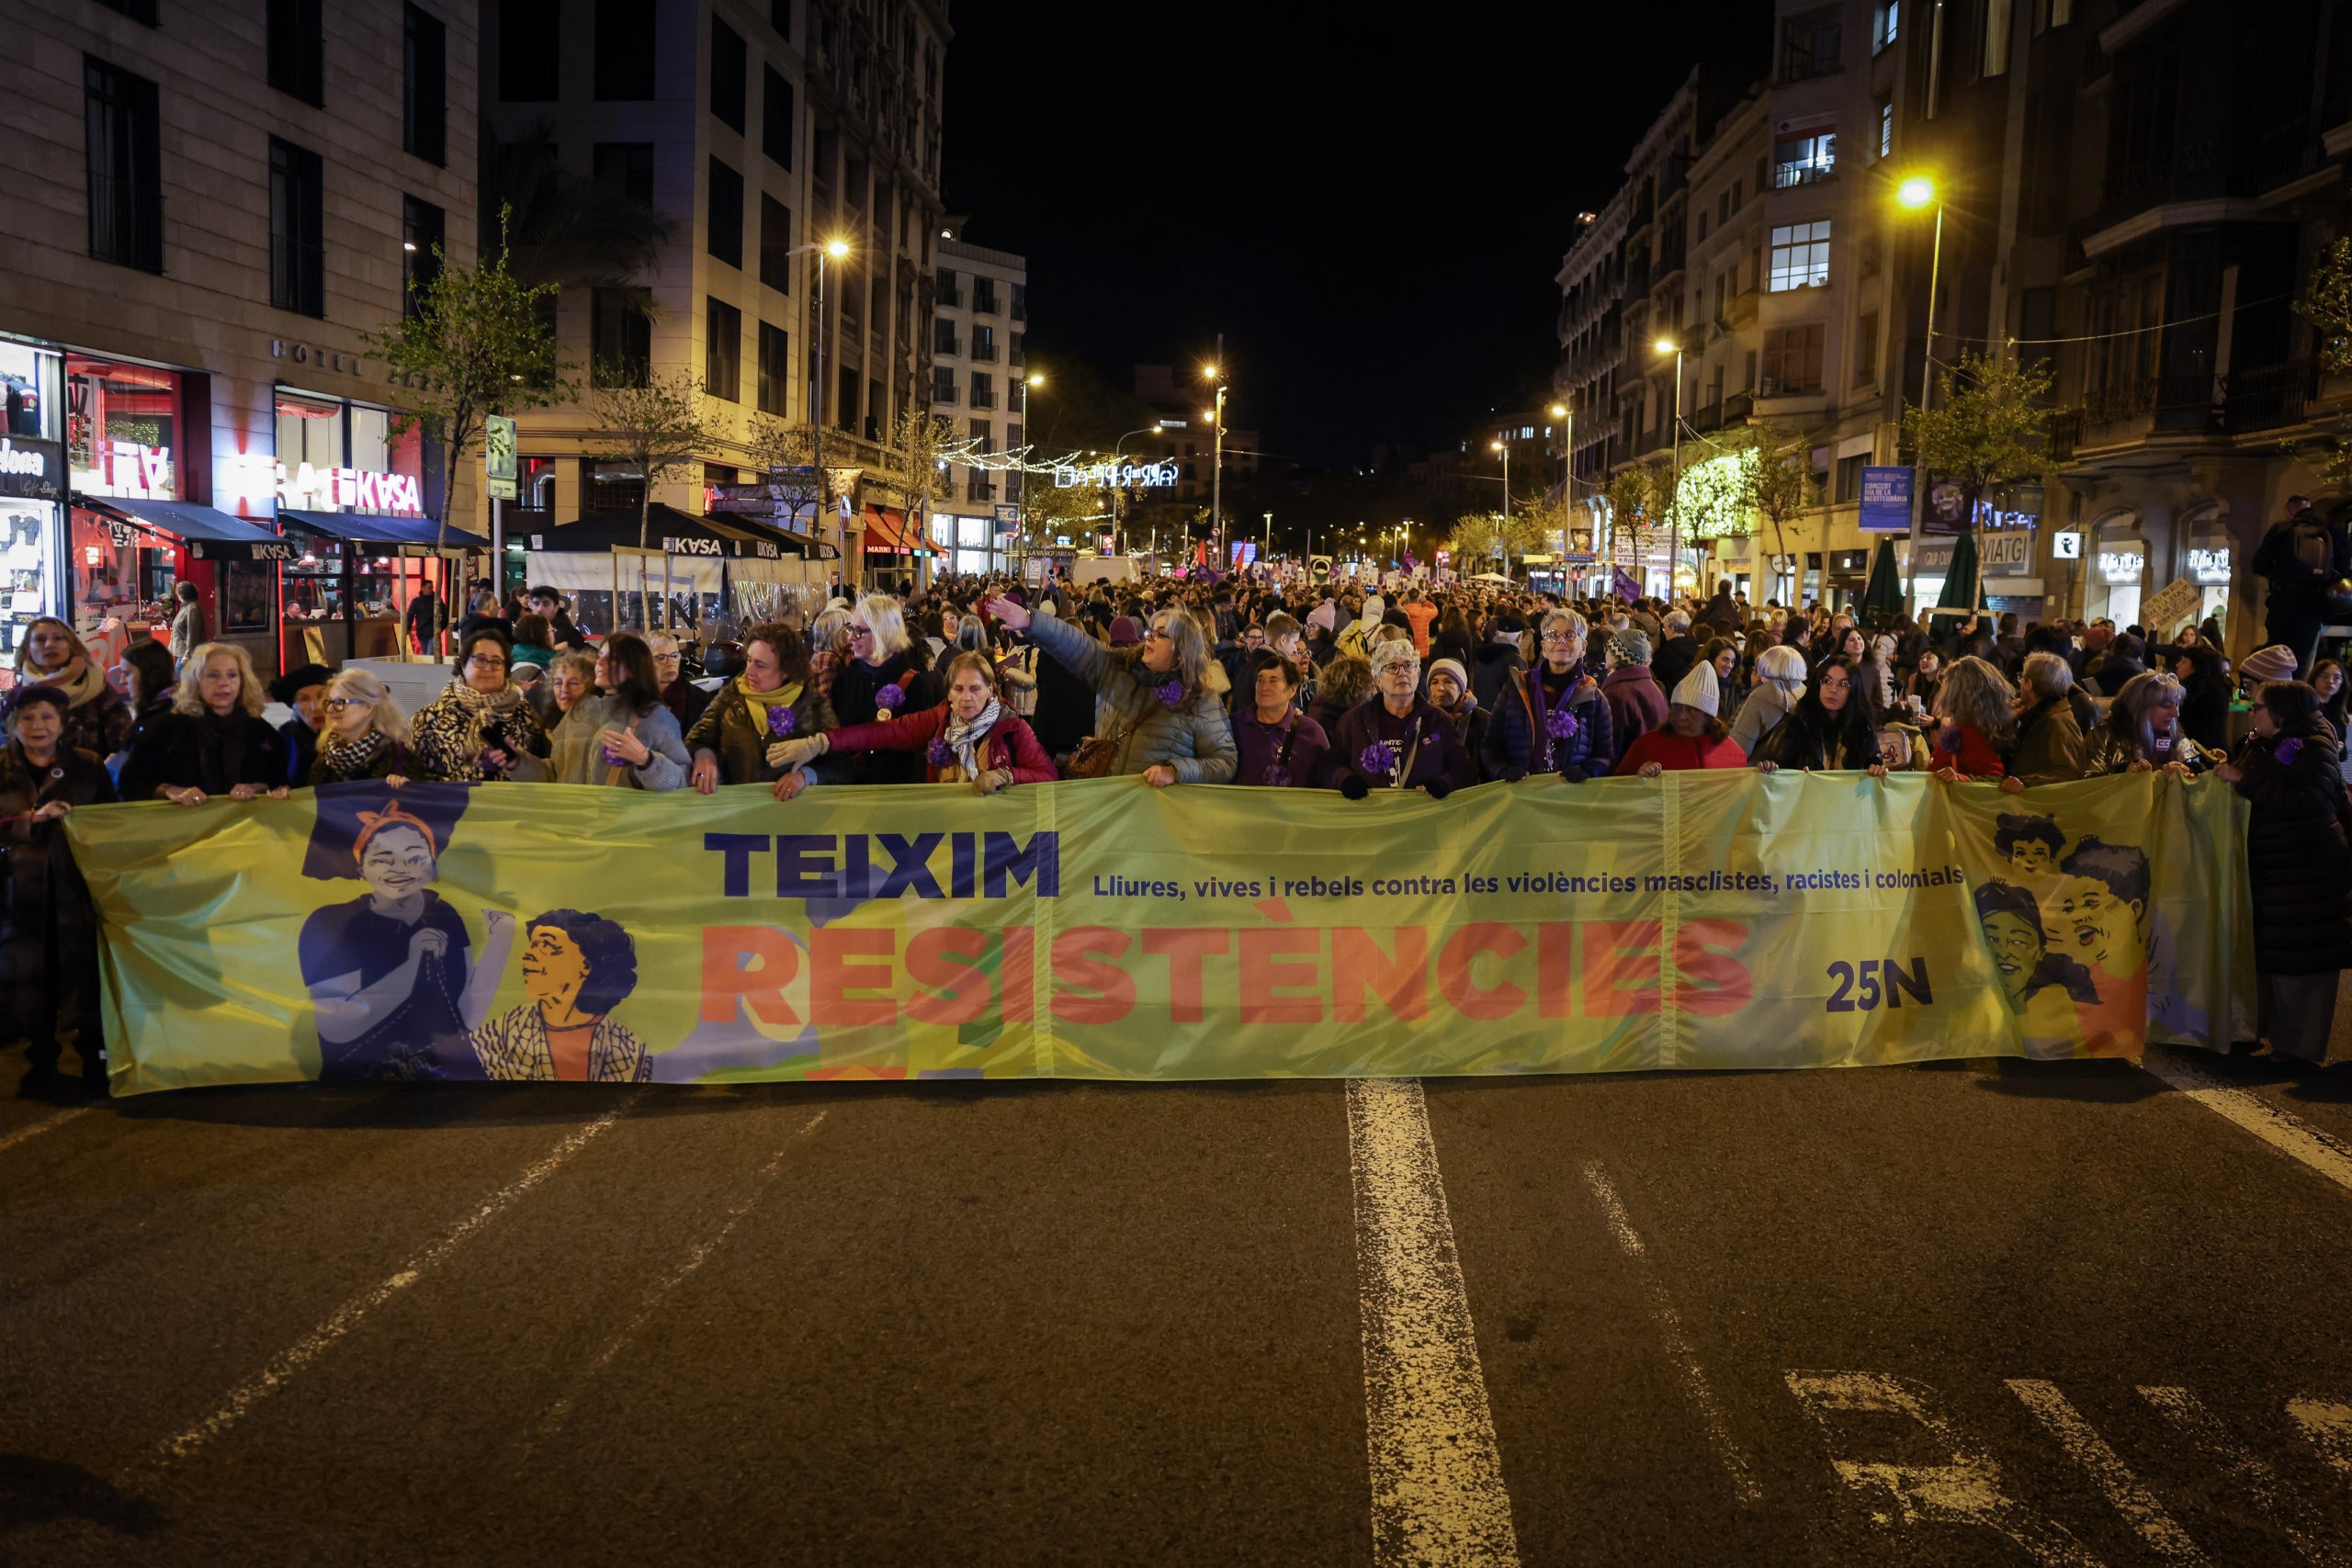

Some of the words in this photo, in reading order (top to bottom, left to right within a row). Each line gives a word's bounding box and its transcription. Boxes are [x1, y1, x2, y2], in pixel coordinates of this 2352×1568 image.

[866, 546, 891, 554] MARNI
[704, 831, 1059, 898] TEIXIM
[1093, 874, 1186, 901] Lliures,
[1193, 876, 1261, 897] vives
[1269, 875, 1276, 897] i
[1284, 874, 1364, 897] rebels
[1372, 875, 1456, 896] contra
[1464, 873, 1499, 895] les
[1507, 871, 1636, 894] violències
[1644, 871, 1779, 895] masclistes,
[1786, 868, 1860, 890] racistes
[1864, 868, 1870, 889] i
[1875, 865, 1964, 889] colonials
[700, 896, 1754, 1026] RESISTÈNCIES
[1825, 956, 1934, 1013] 25N
